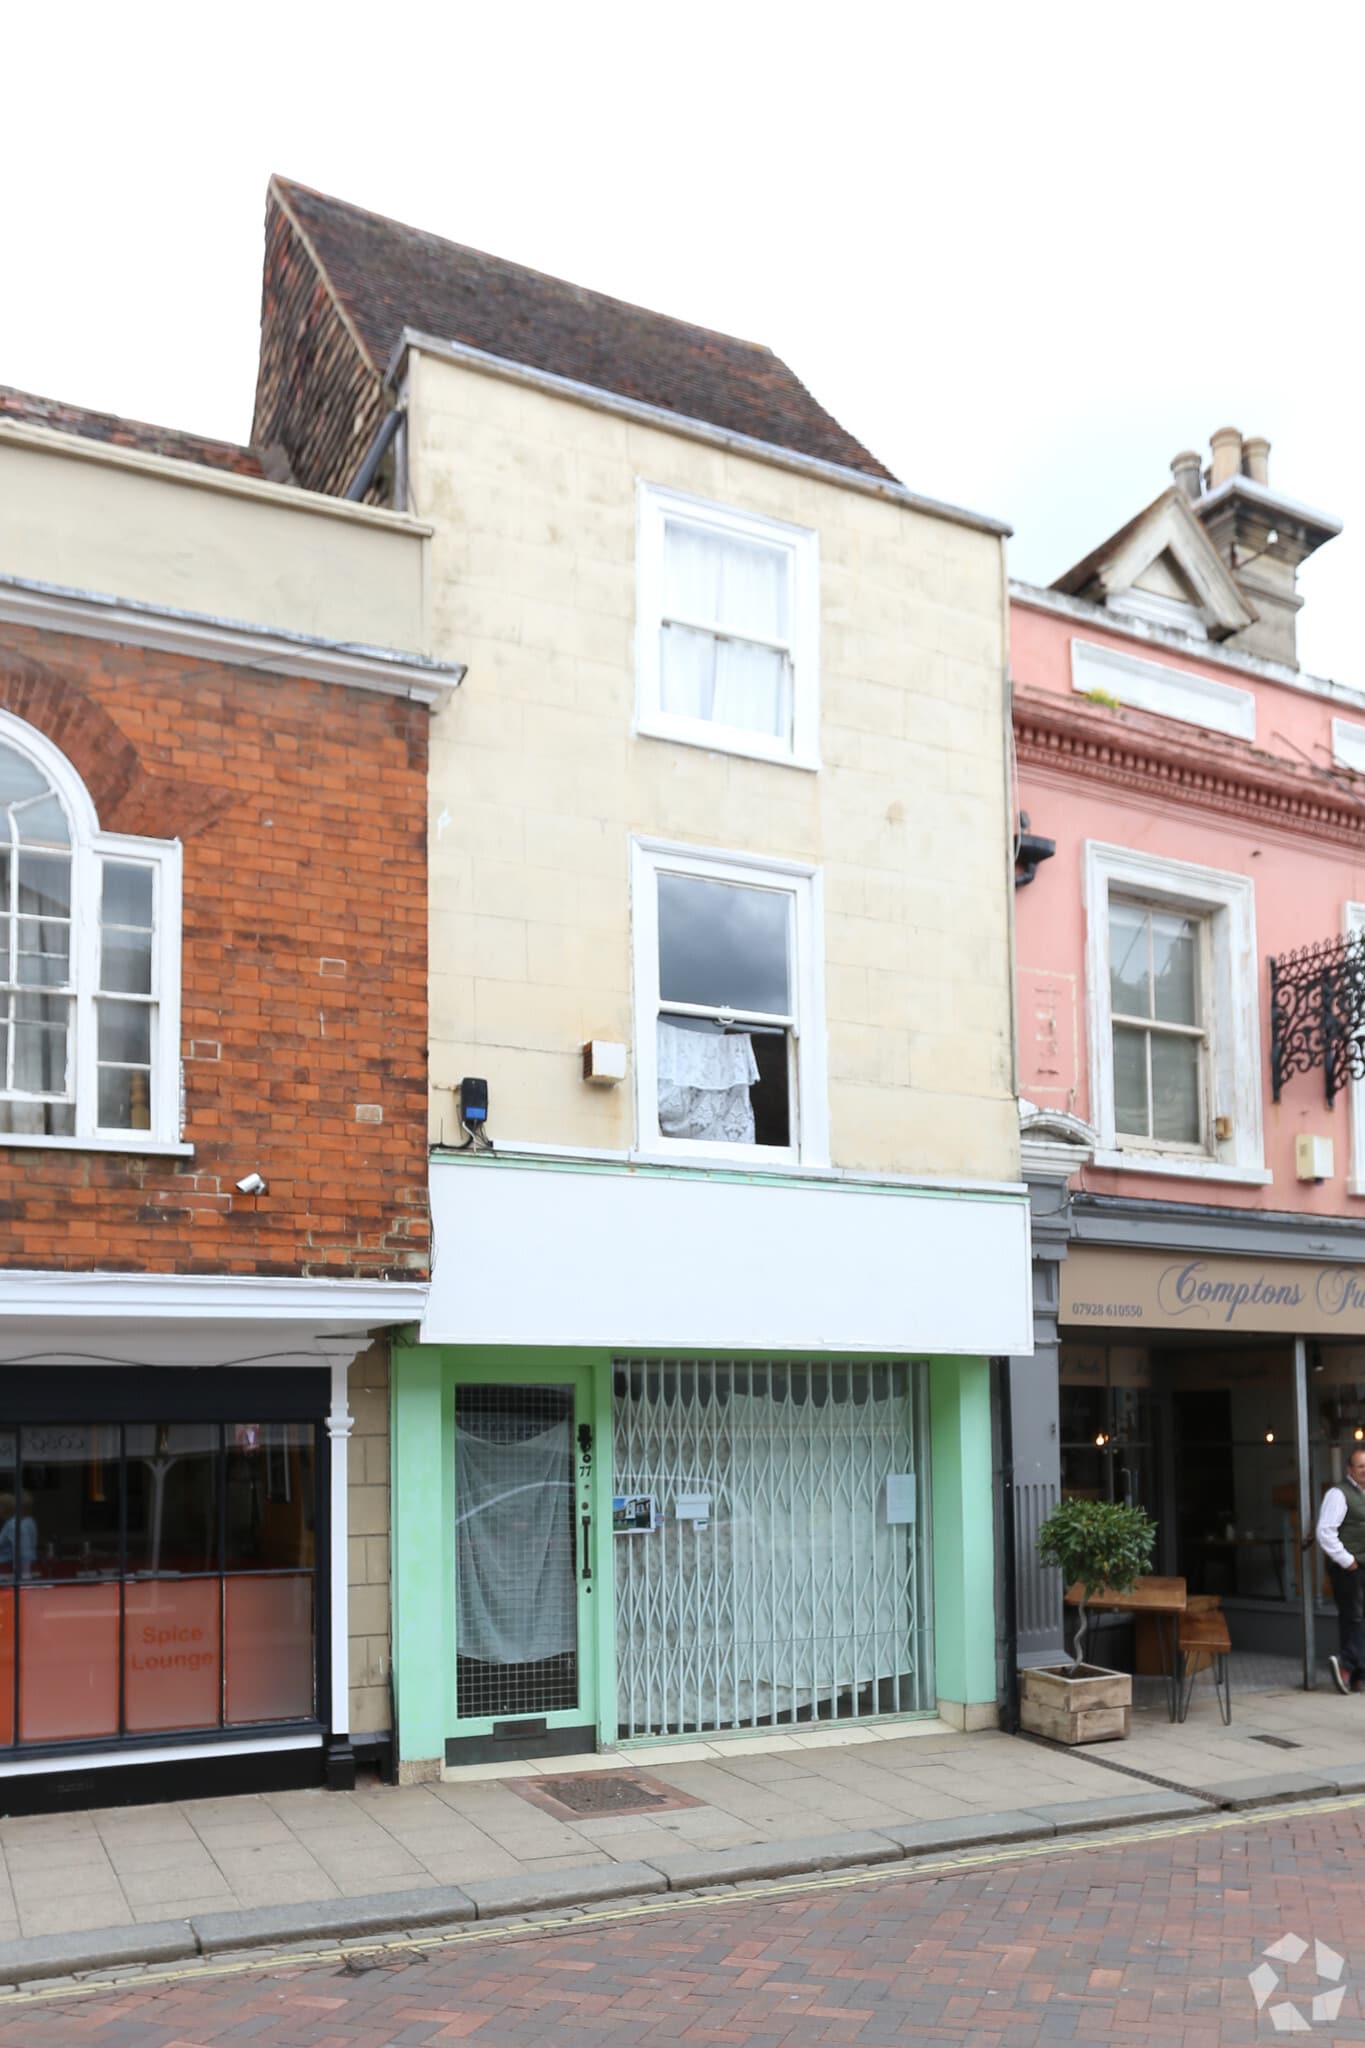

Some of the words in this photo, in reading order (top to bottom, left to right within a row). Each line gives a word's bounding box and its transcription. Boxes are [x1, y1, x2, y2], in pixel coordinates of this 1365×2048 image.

[1157, 1261, 1305, 1322] Comptons
[1072, 1302, 1104, 1316] 07928
[579, 1465, 592, 1477] 77
[143, 1625, 203, 1648] Spice
[132, 1652, 213, 1672] Lounge
